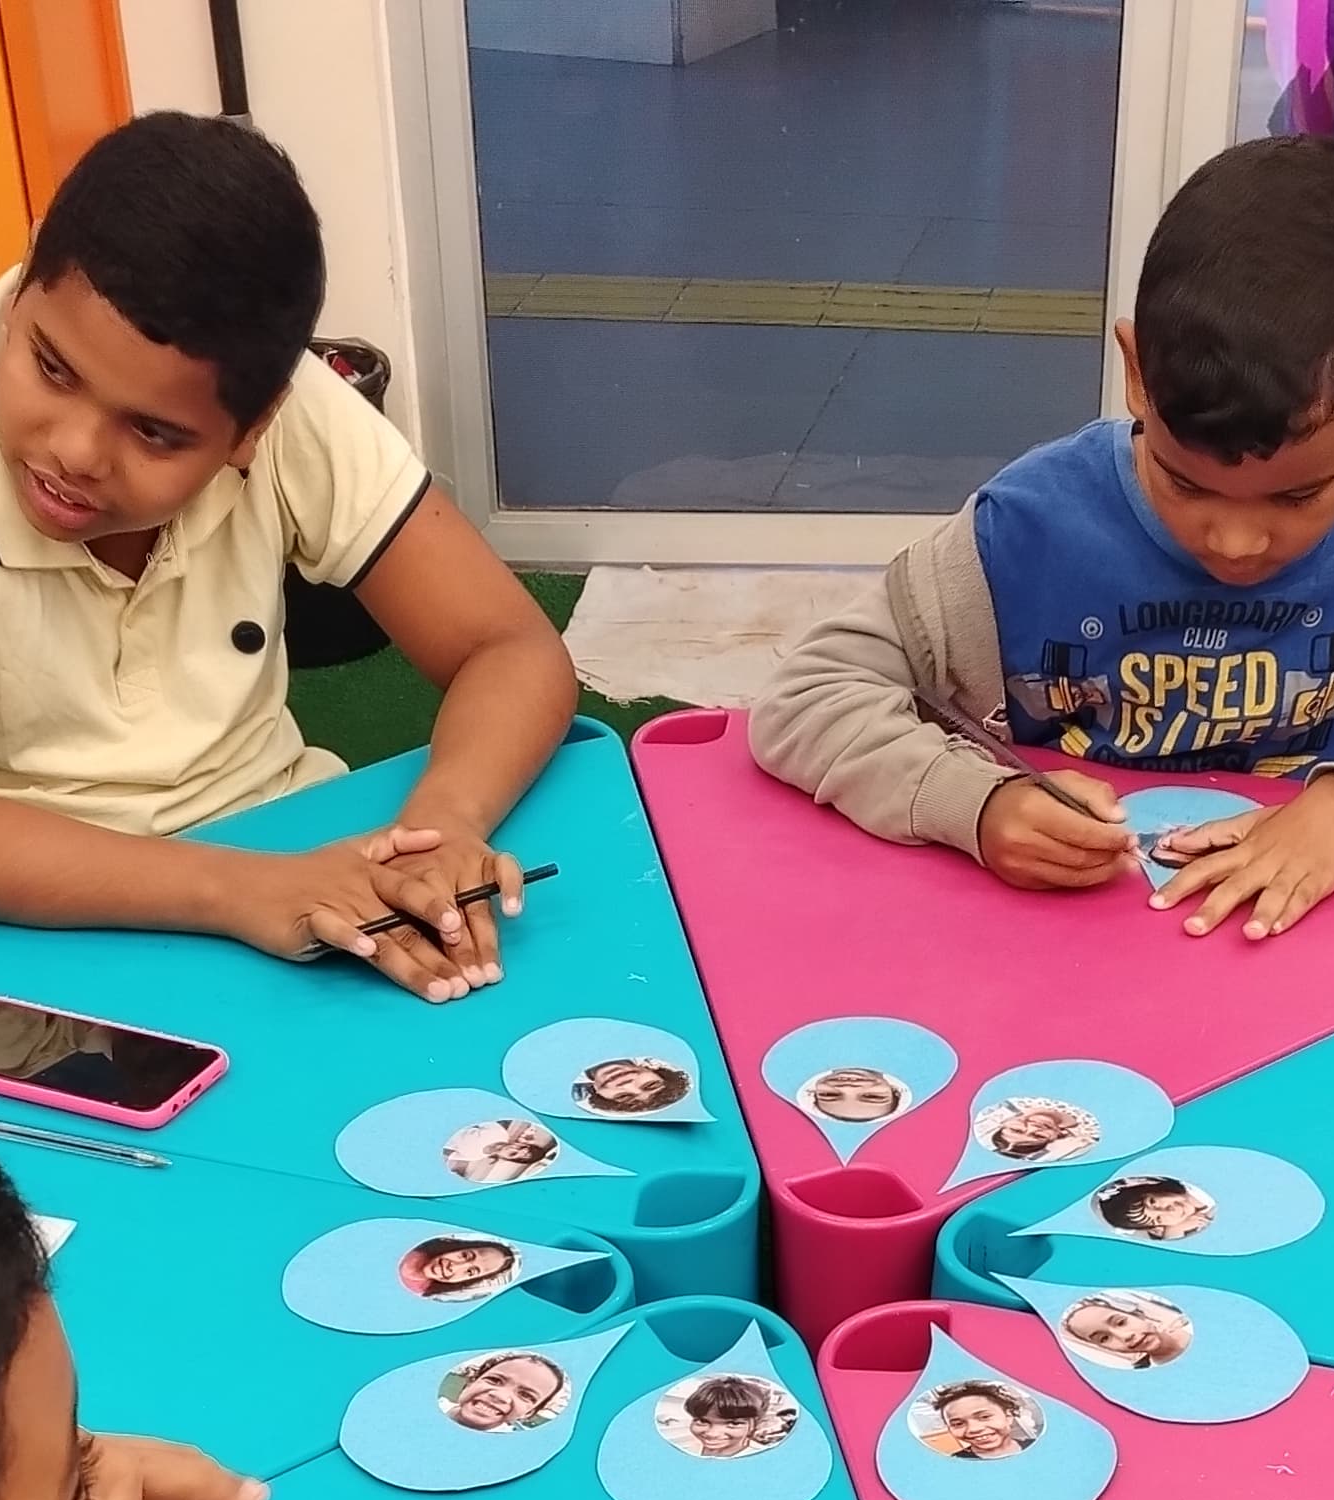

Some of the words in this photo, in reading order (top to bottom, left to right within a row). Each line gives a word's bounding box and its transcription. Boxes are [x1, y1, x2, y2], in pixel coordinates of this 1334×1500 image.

[1182, 627, 1228, 650] CLUB
[1120, 651, 1277, 719] SPEED
[1114, 702, 1163, 753] IS
